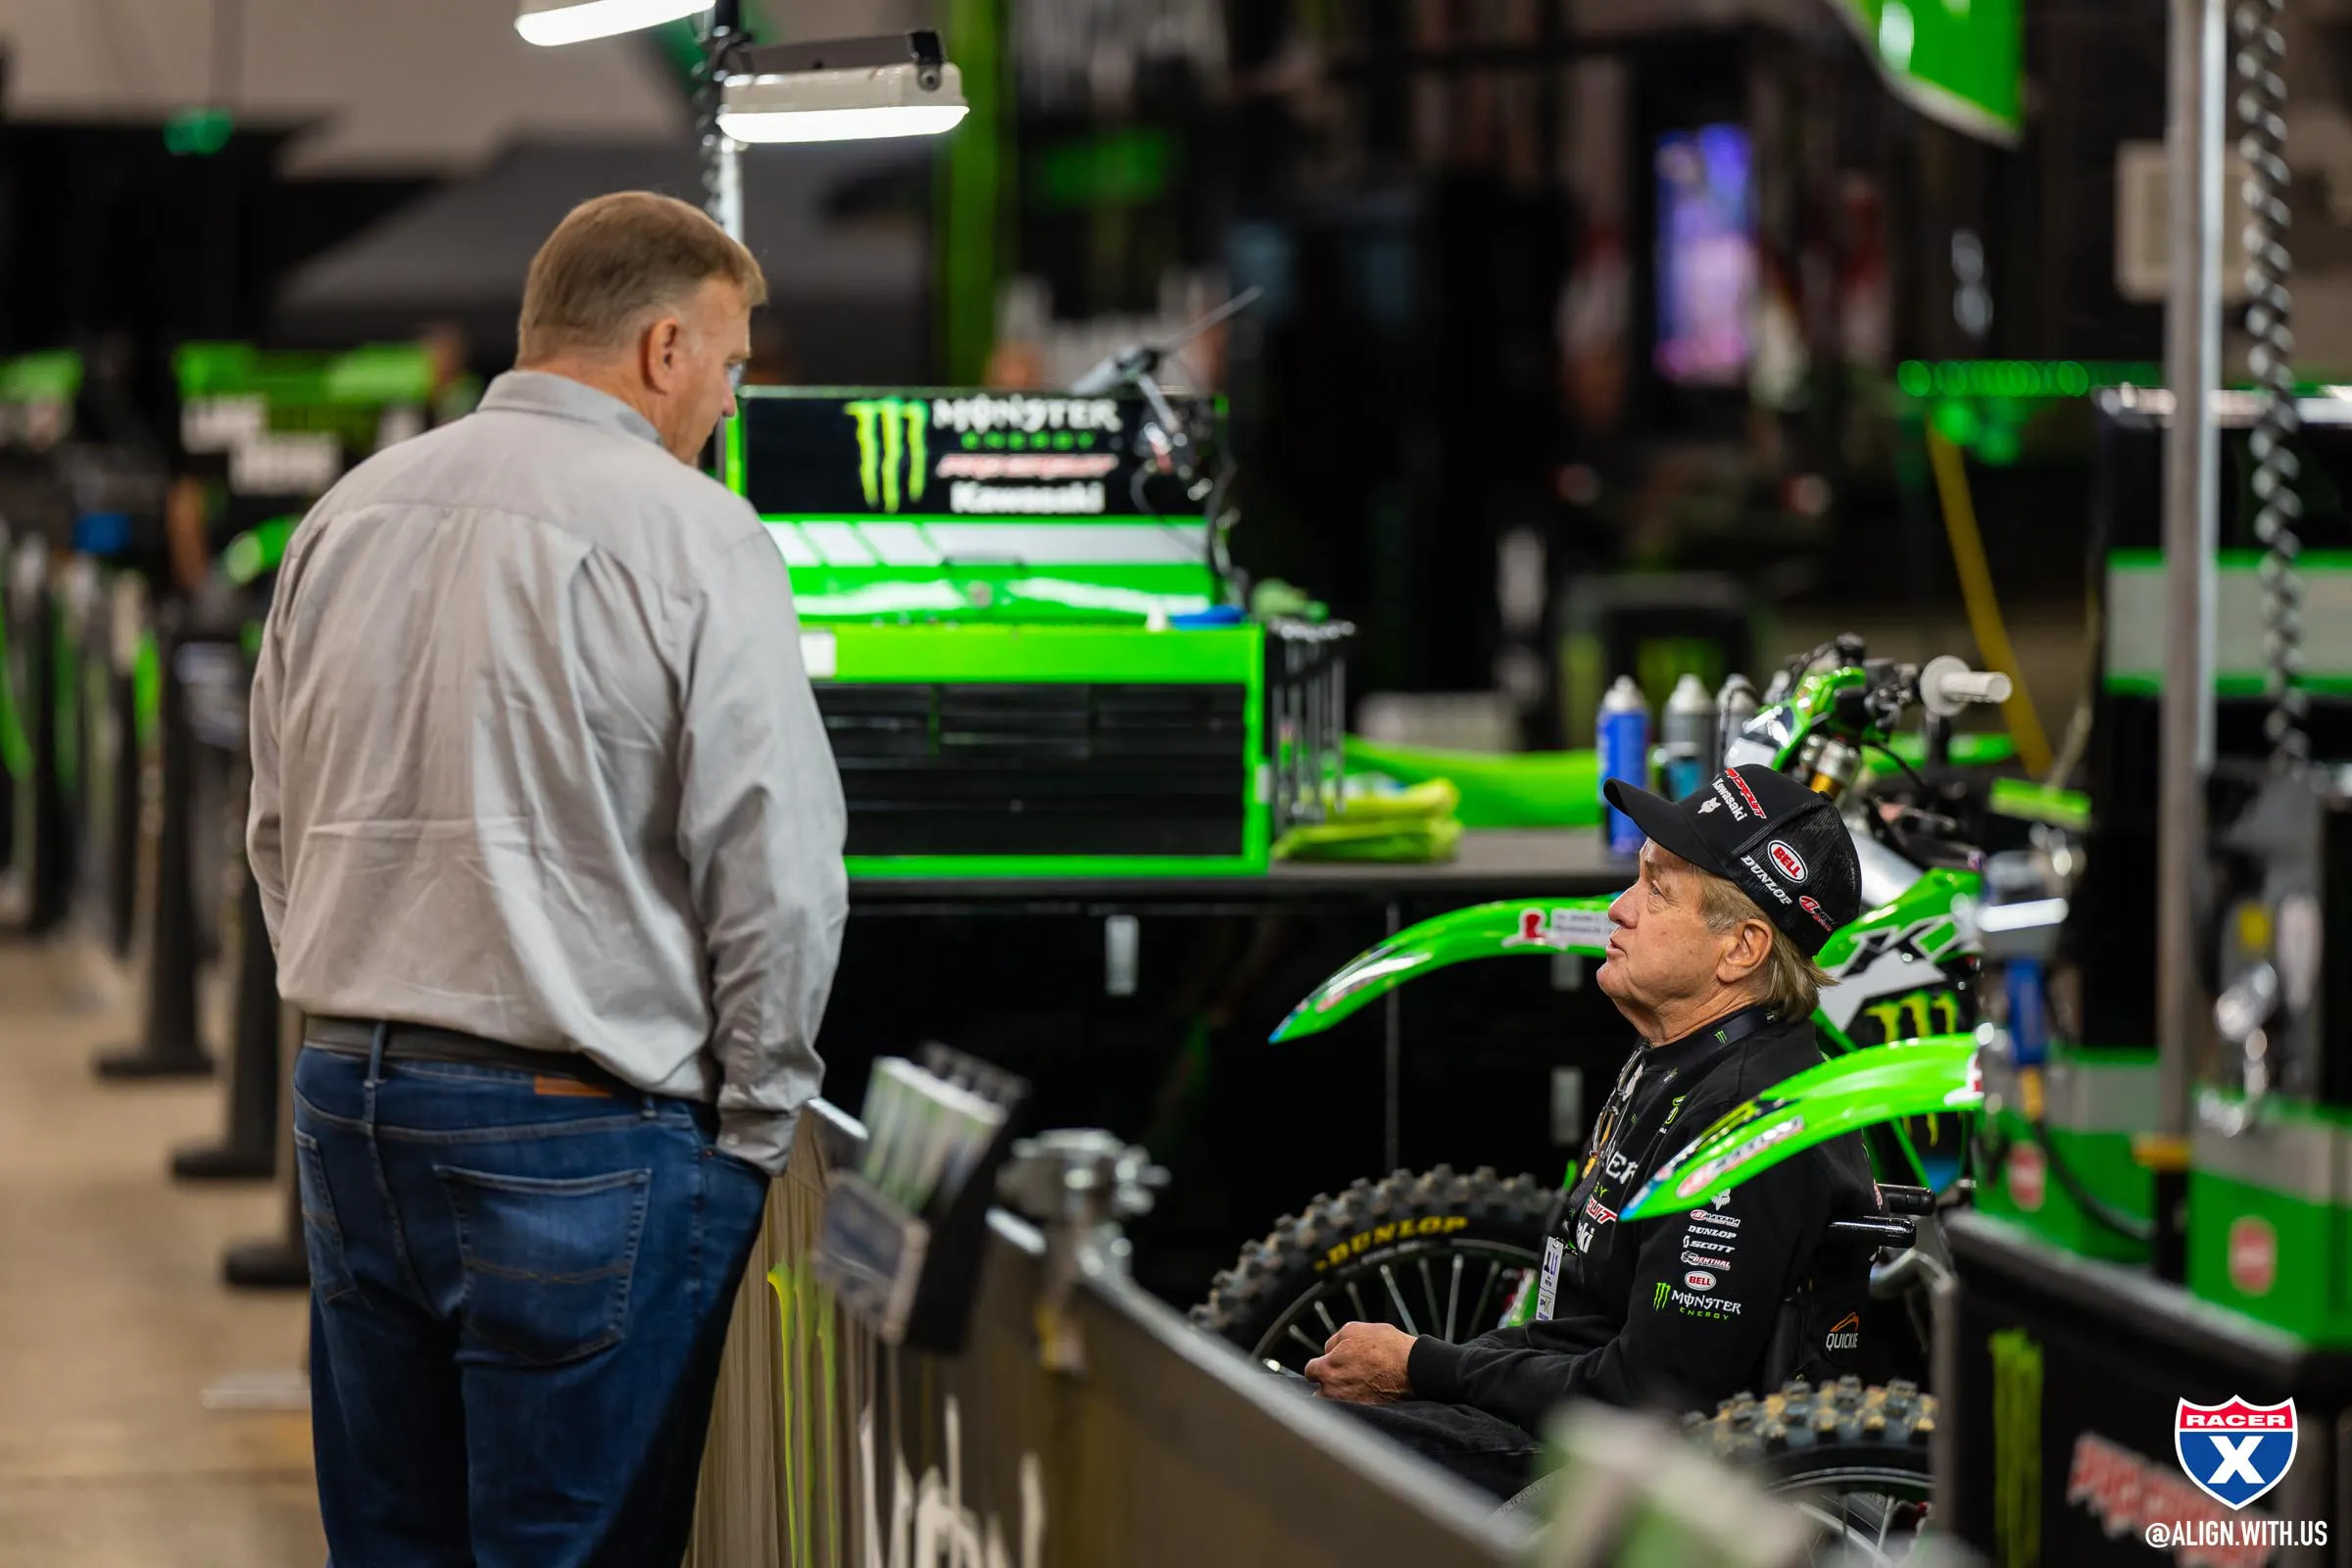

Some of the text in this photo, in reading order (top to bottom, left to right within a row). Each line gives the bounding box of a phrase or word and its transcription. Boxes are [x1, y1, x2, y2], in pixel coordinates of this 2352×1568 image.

[1712, 778, 1748, 821] Kawasaki
[1773, 846, 1803, 878] BELL
[1740, 856, 1792, 905] DUNLOP
[1328, 1216, 1468, 1265] DUNLOP
[1688, 1225, 1737, 1239] DUNLOP
[1690, 1240, 1736, 1253] SCOTT
[1689, 1276, 1711, 1286] BELL
[1671, 1290, 1741, 1314] MONSTER
[1679, 1306, 1729, 1320] ENERGY
[1826, 1332, 1859, 1351] QUICKIE
